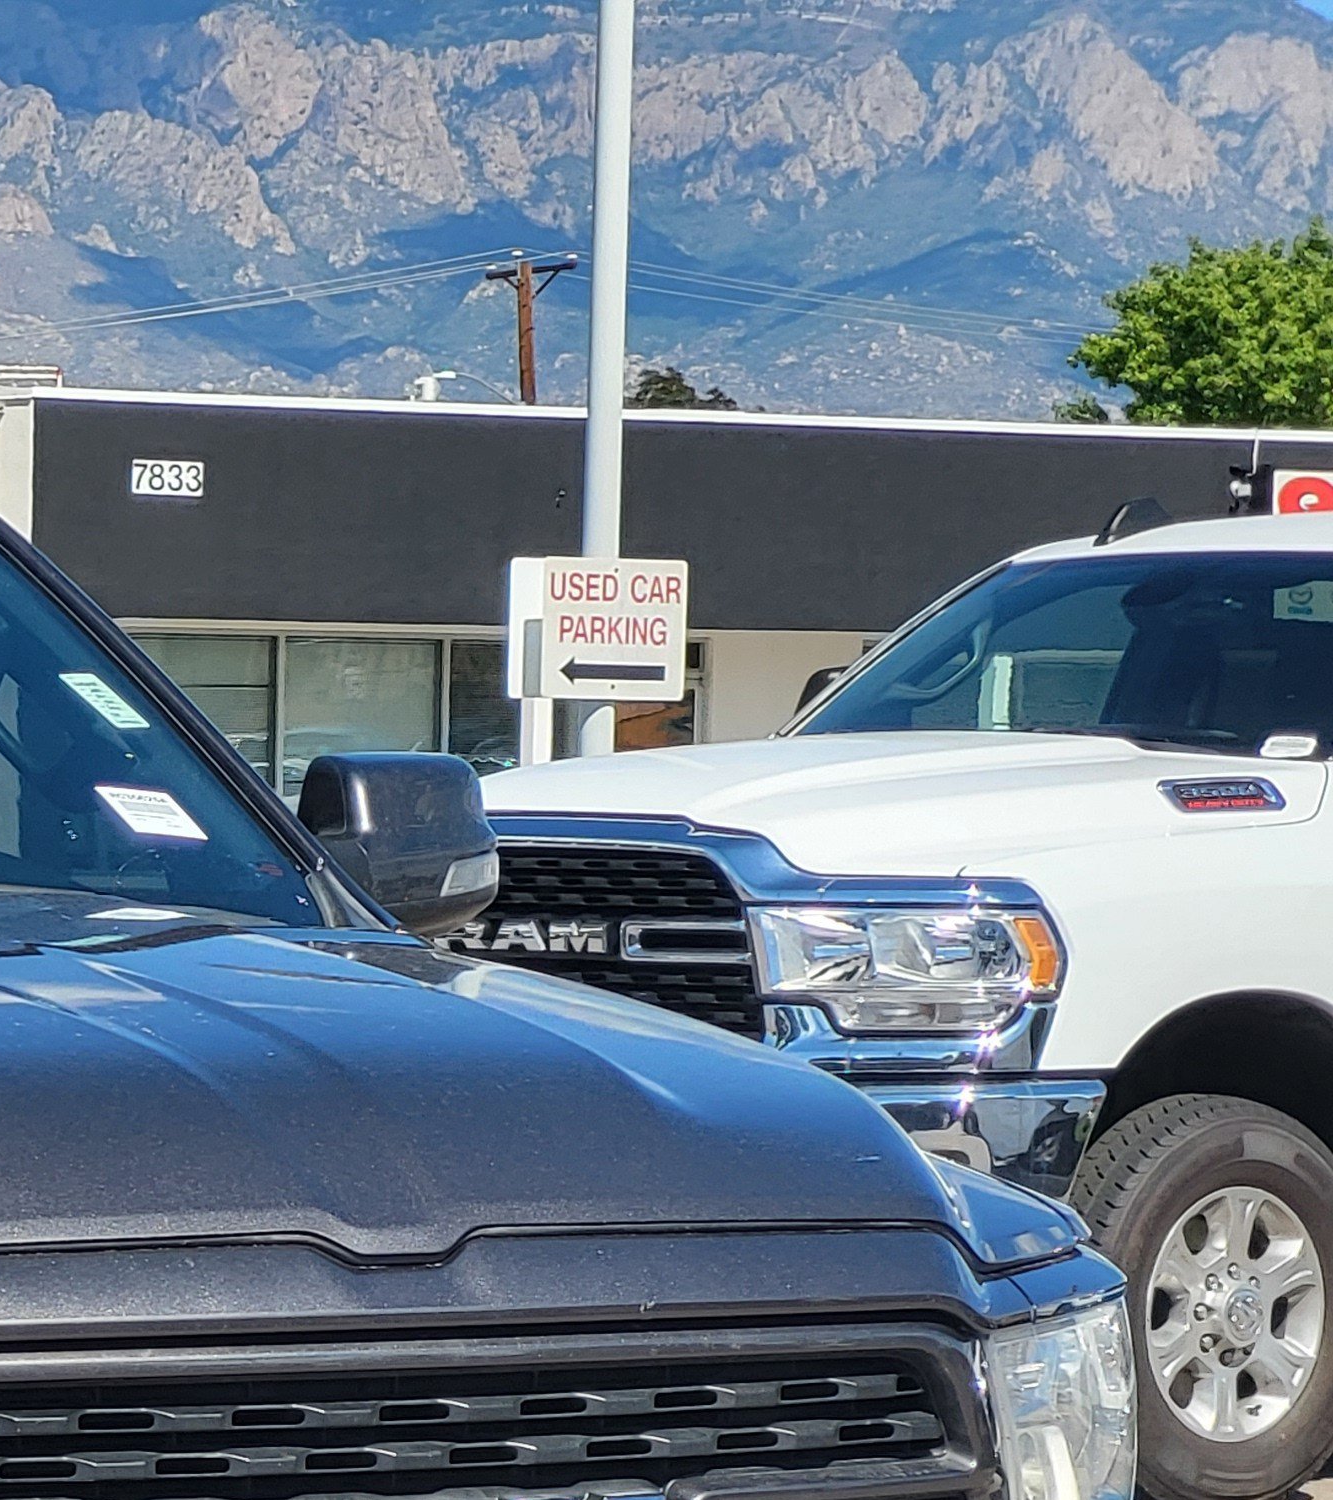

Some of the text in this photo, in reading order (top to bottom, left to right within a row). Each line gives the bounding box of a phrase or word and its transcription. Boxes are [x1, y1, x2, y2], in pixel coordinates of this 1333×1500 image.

[133, 463, 202, 492] 7833
[550, 571, 682, 604] USED CAR
[558, 615, 668, 646] PARKING
